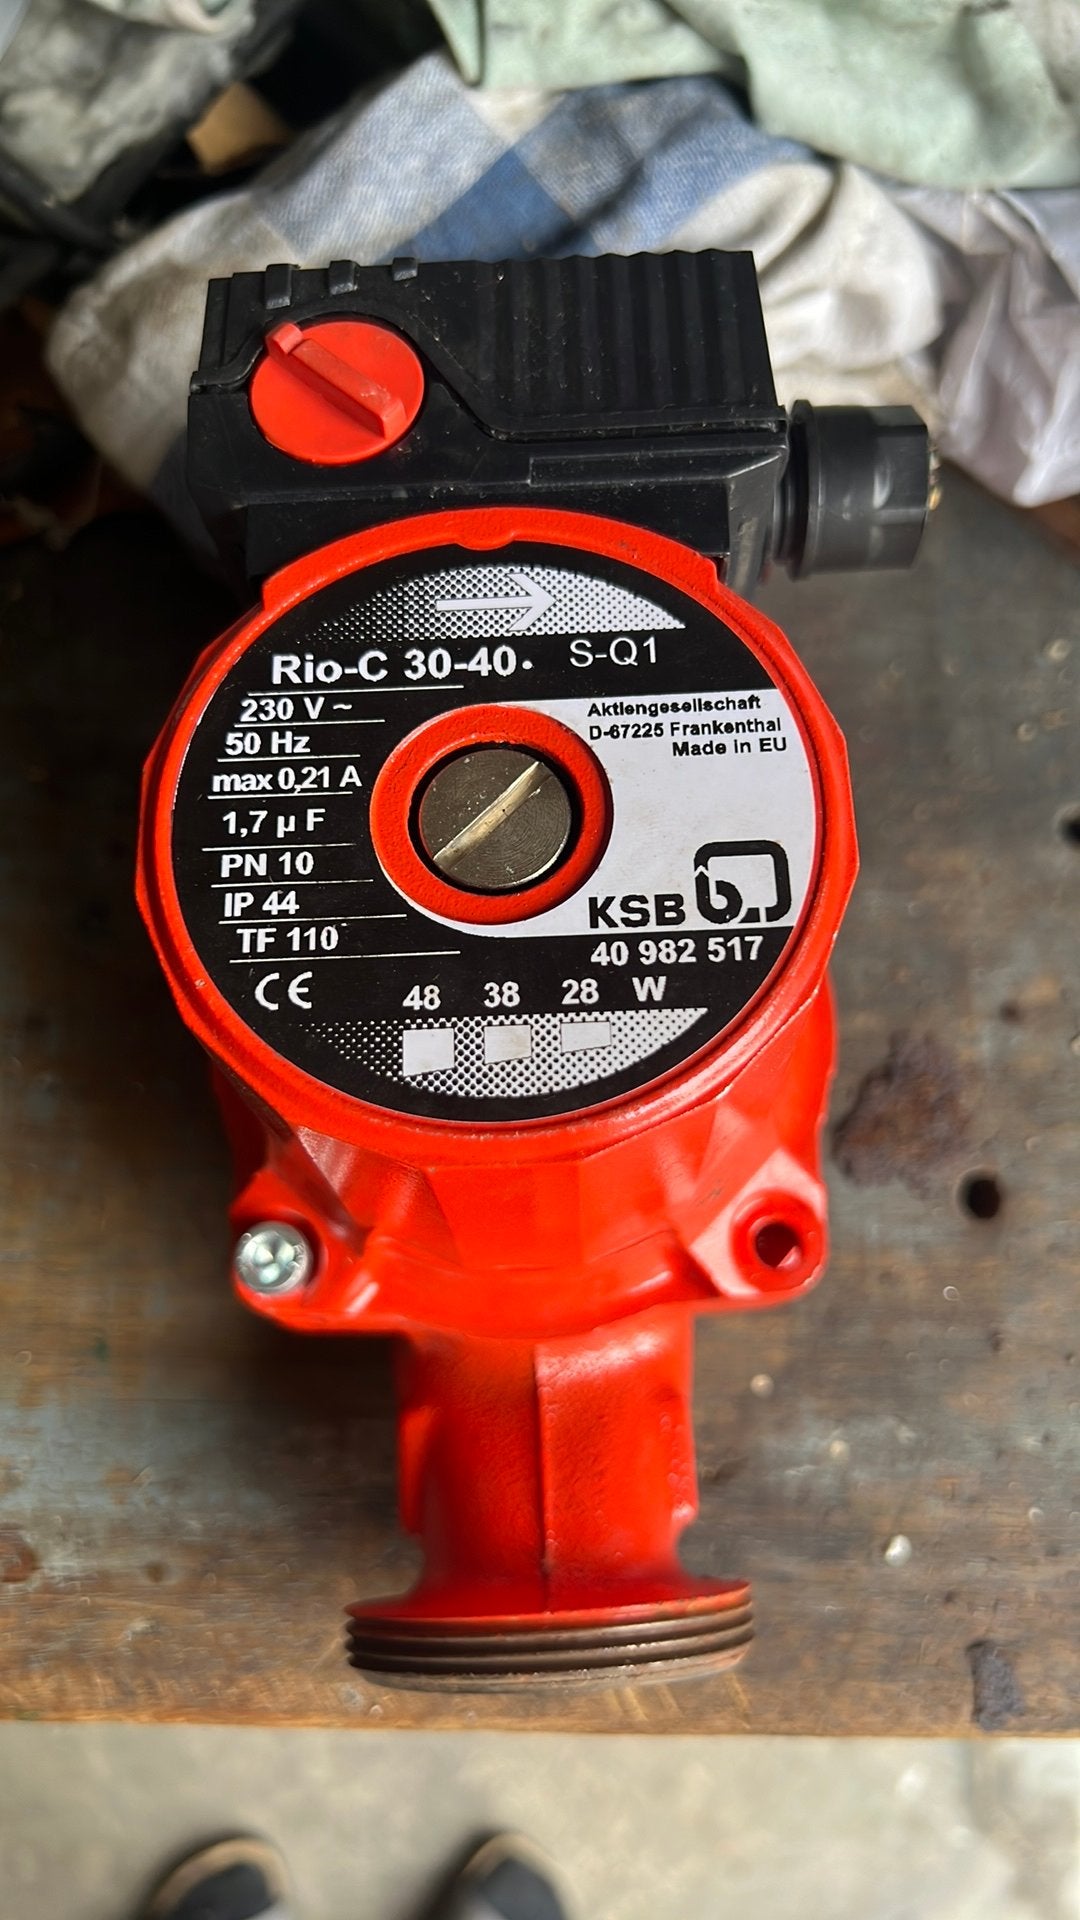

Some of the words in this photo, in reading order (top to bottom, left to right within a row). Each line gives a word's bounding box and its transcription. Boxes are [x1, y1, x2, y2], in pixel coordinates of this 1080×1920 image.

[569, 636, 657, 667] S-Q1
[272, 650, 388, 684] Rio-C
[240, 698, 294, 722] 230
[304, 696, 325, 719] V
[587, 695, 761, 717] Aktiengesellschaft
[589, 722, 664, 740] D-67225
[671, 717, 782, 736] Frankenthal
[225, 732, 261, 755] 50
[271, 731, 311, 754] Hz
[672, 740, 727, 757] Made
[733, 739, 751, 754] in
[759, 737, 787, 752] EU
[212, 773, 273, 792] max
[278, 767, 331, 794] 0,21
[339, 765, 362, 787] A
[222, 811, 268, 838] 1,7
[307, 808, 326, 831] F
[220, 853, 267, 878] PN
[278, 851, 314, 875] 10
[224, 892, 254, 917] IP
[262, 890, 300, 915] 44
[588, 893, 686, 928] KSB
[236, 928, 277, 953] TF
[287, 926, 338, 951] 110
[590, 941, 629, 966] 40
[638, 938, 697, 965] 982
[707, 935, 763, 962] 517
[402, 984, 441, 1011] 48
[483, 981, 520, 1008] 38
[561, 978, 600, 1005] 28
[631, 975, 666, 1001] W
